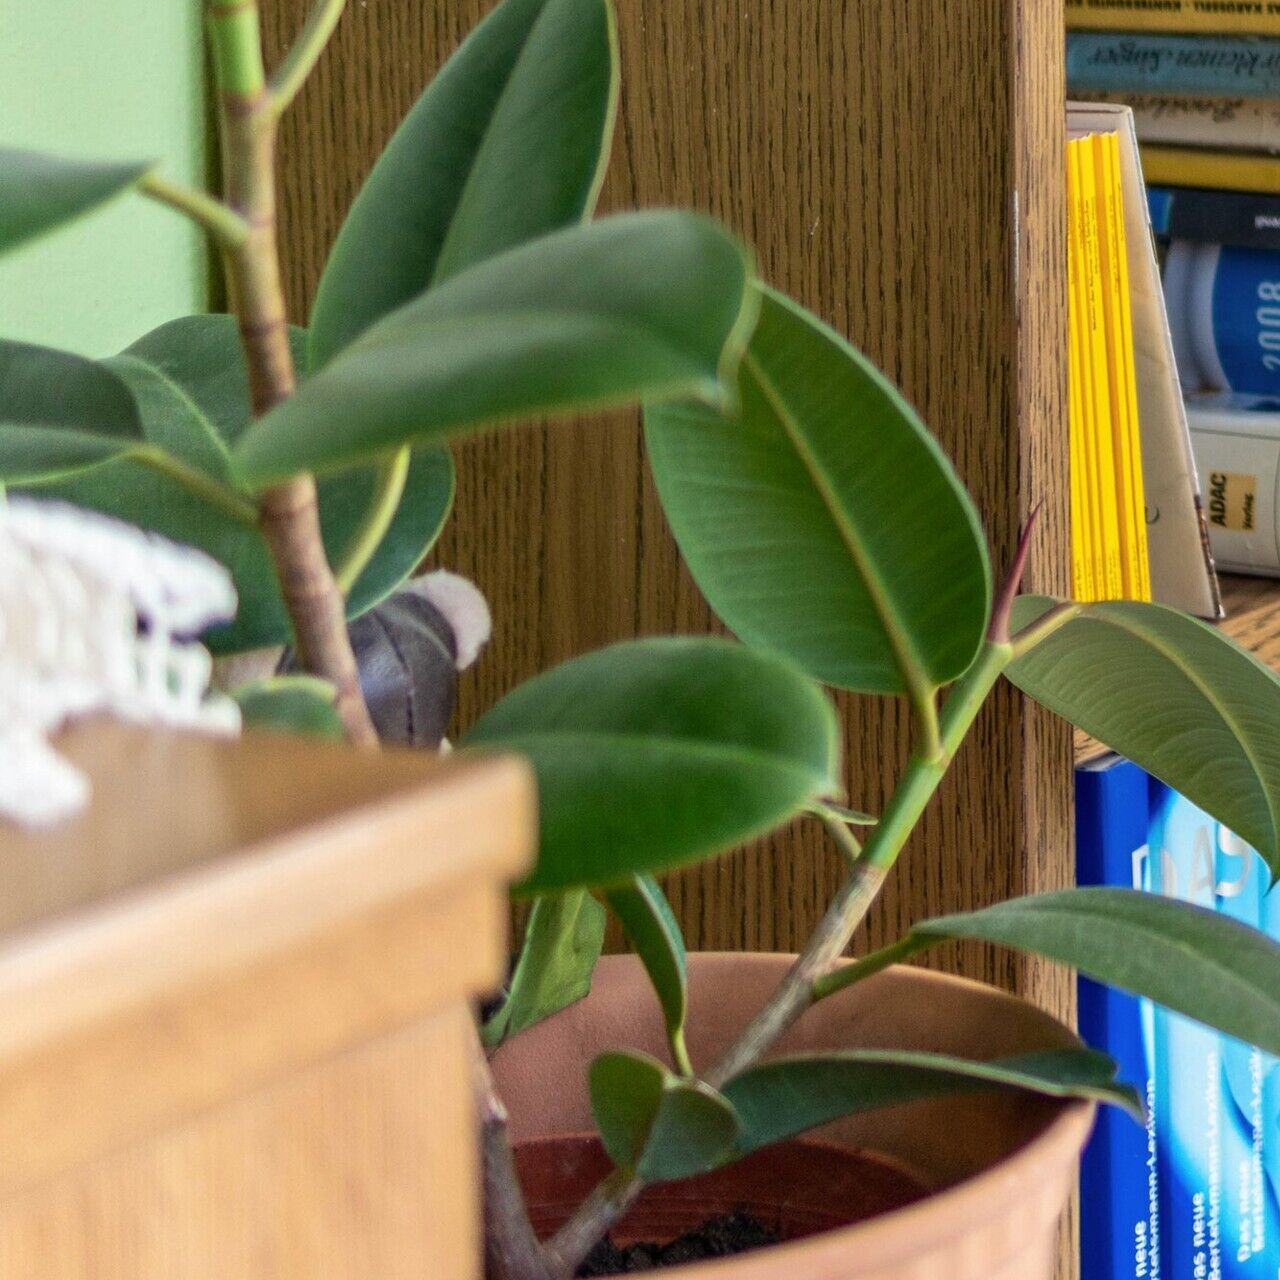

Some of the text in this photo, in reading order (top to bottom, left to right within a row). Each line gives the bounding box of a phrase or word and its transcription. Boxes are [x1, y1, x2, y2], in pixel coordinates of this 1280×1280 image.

[1209, 472, 1228, 528] ADAC
[1135, 1221, 1147, 1278] neue
[1193, 1192, 1206, 1280] as neue
